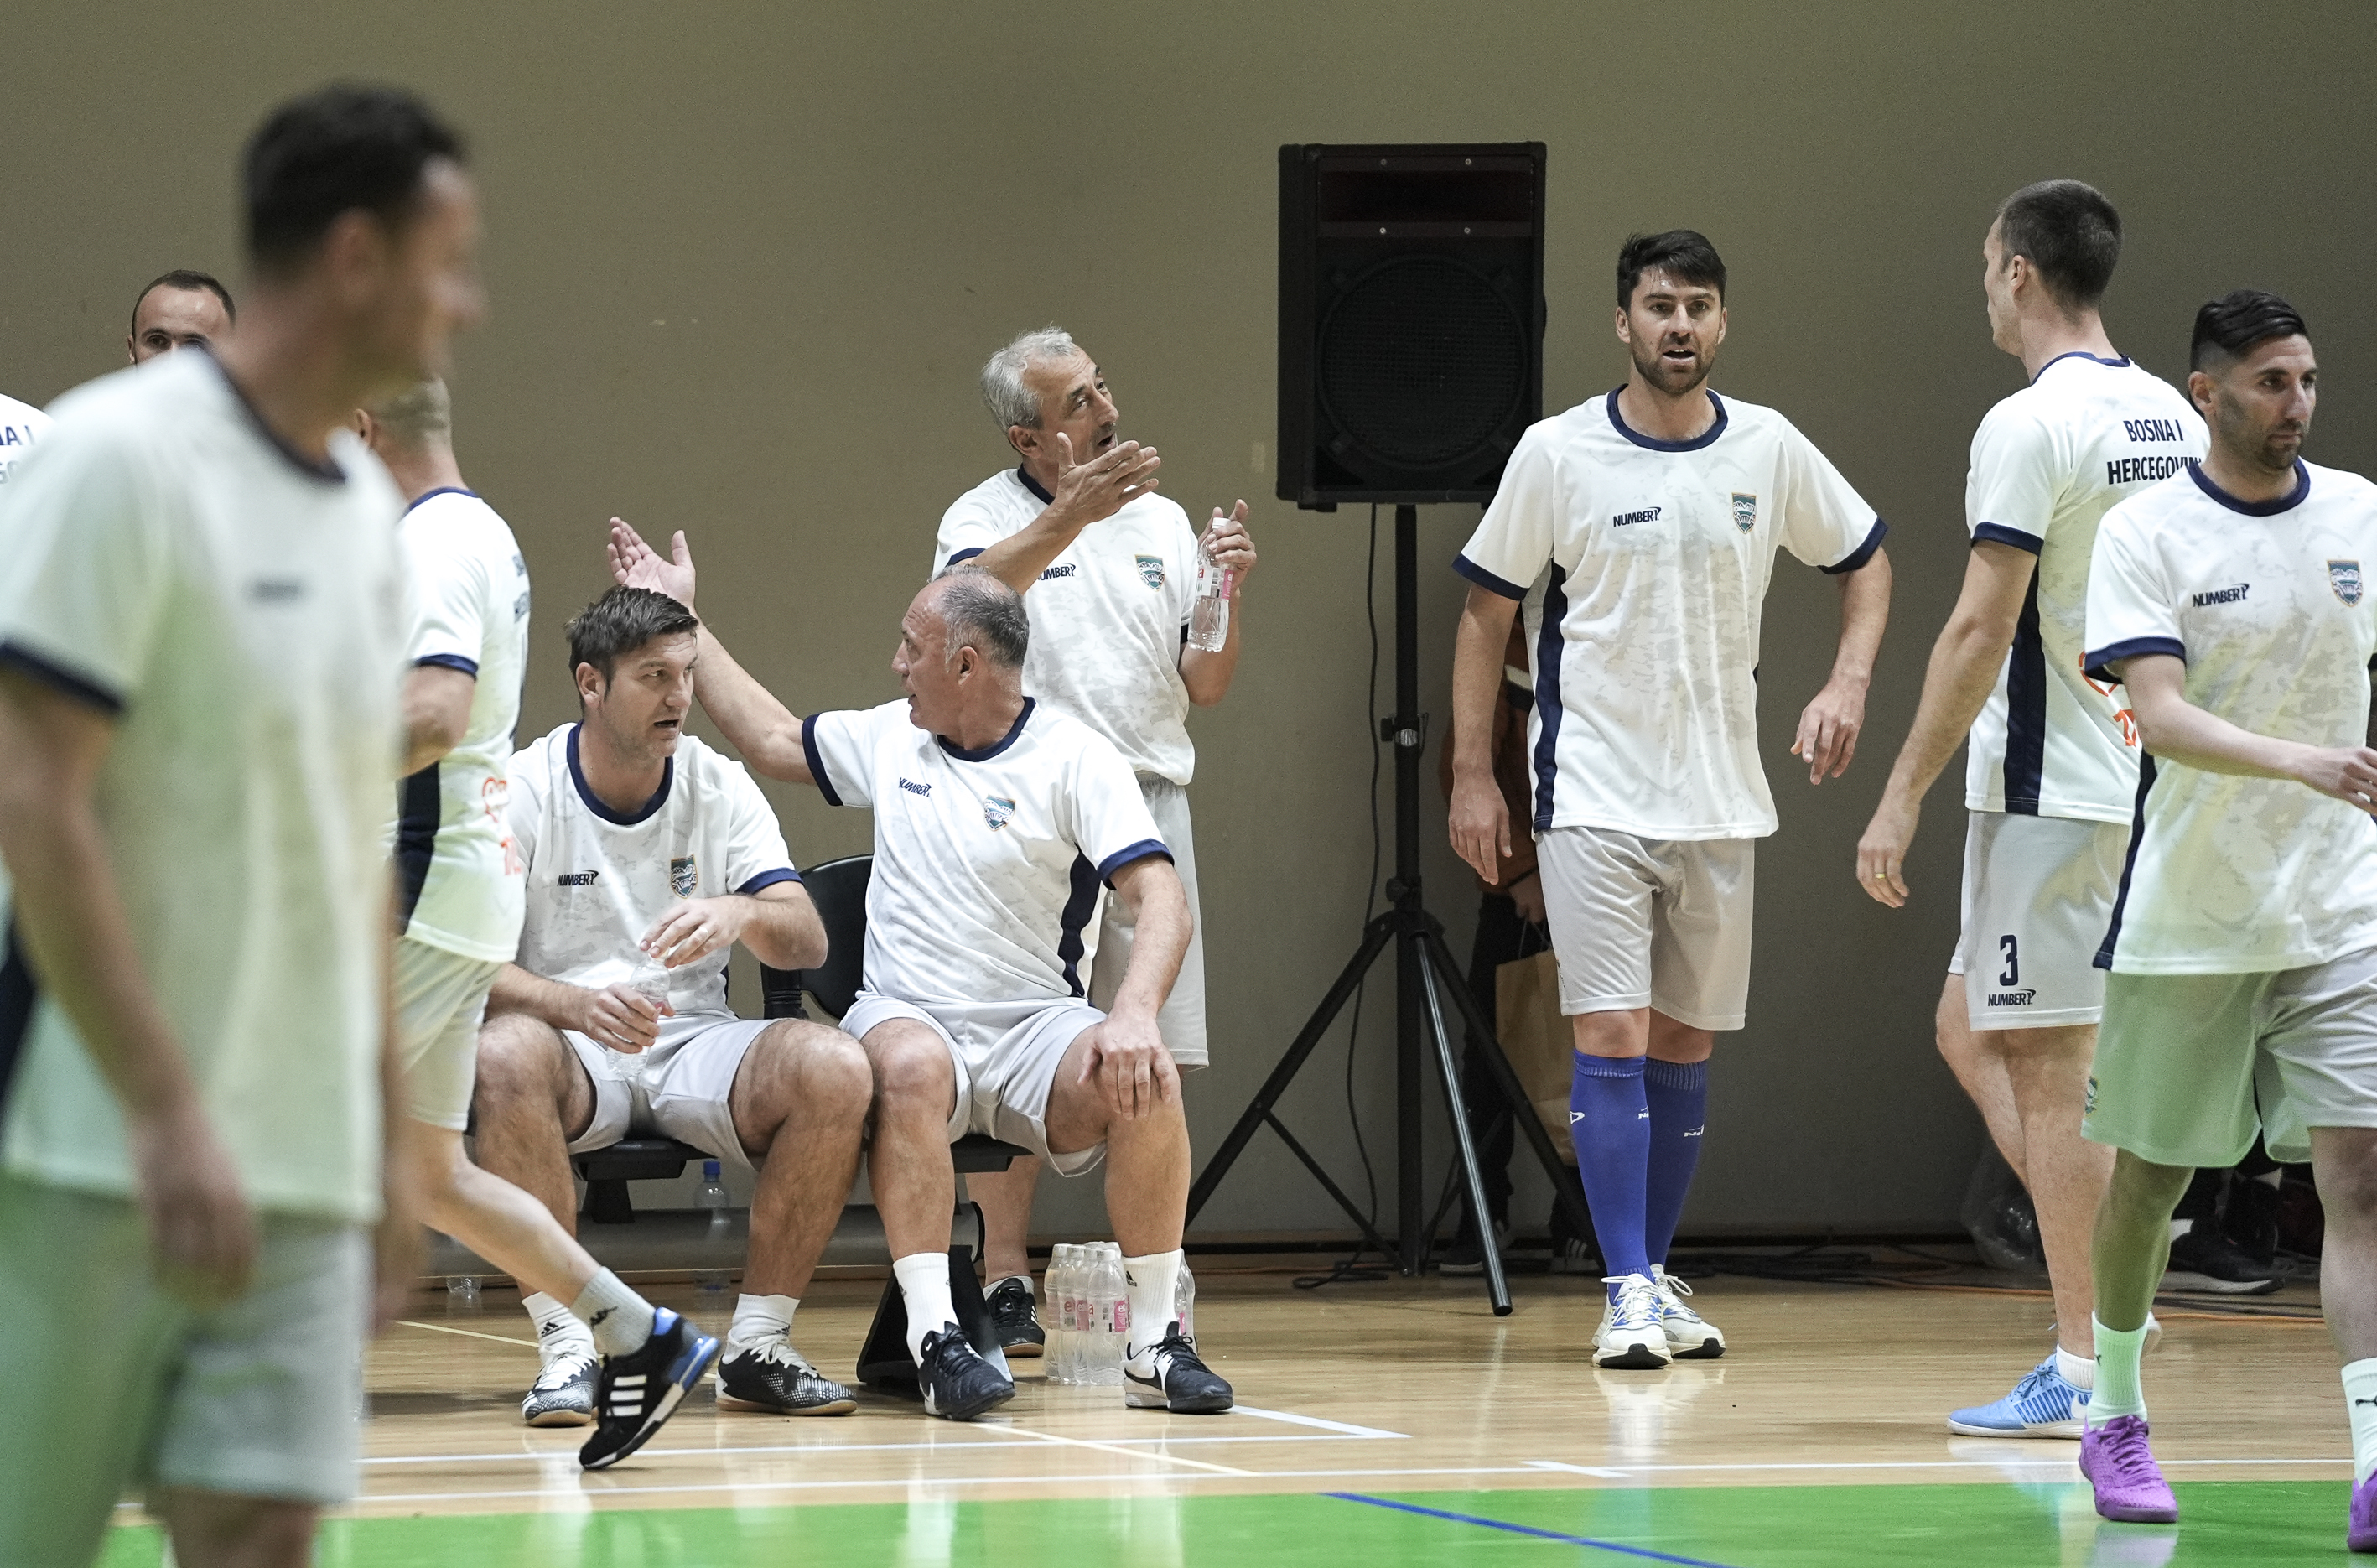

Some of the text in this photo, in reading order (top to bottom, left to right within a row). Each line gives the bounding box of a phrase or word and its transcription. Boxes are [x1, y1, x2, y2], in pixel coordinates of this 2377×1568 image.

[2123, 419, 2184, 442] BOSNA I
[1038, 563, 1076, 580] UMBER1
[1999, 934, 2018, 986] 3
